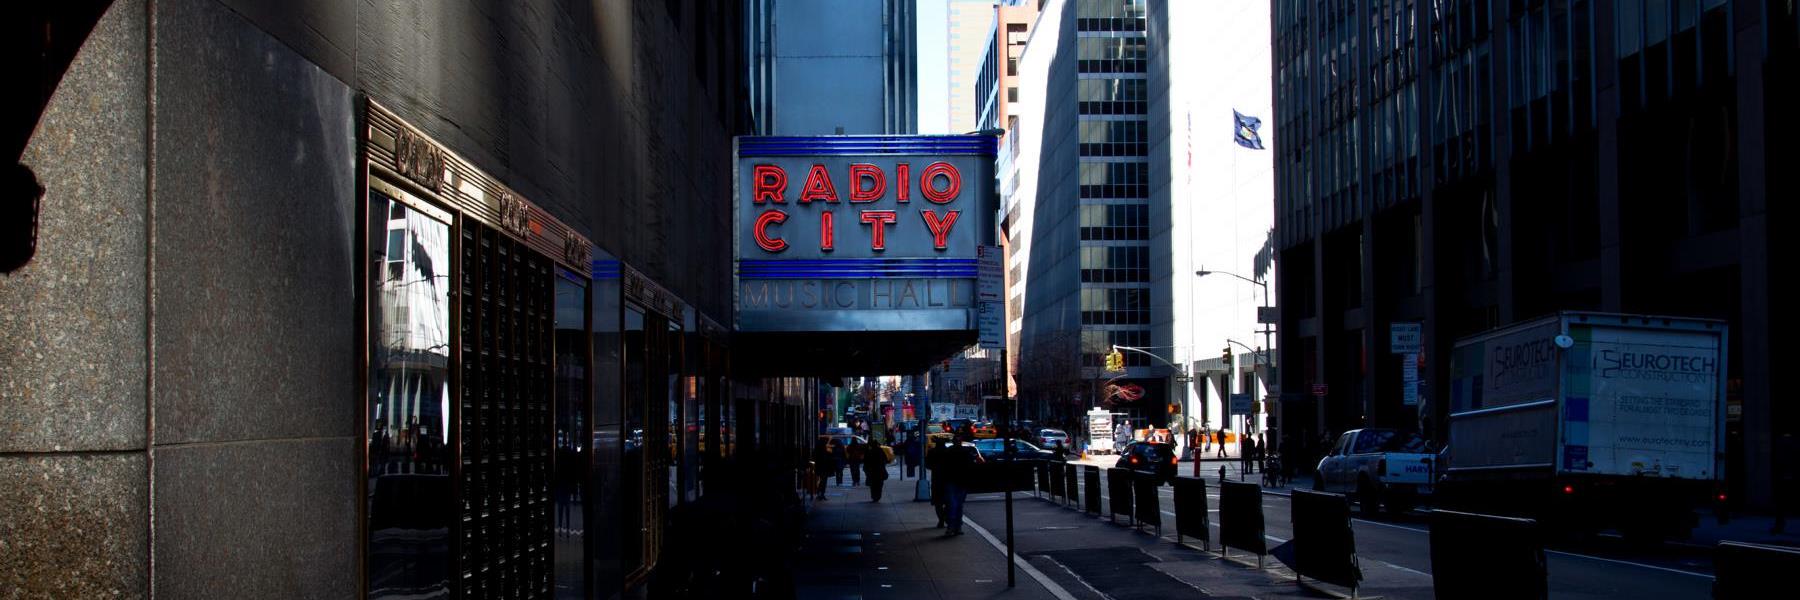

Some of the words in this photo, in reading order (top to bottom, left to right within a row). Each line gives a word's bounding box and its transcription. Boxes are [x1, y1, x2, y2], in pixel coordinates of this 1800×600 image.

[753, 161, 962, 205] RADIO
[753, 209, 961, 253] CITY
[744, 281, 855, 308] MUSIC
[872, 280, 969, 308] HALL
[1505, 337, 1555, 370] EUROTECH
[1622, 352, 1715, 373] EUROTECH
[1621, 368, 1707, 384] CONSTRUCTION
